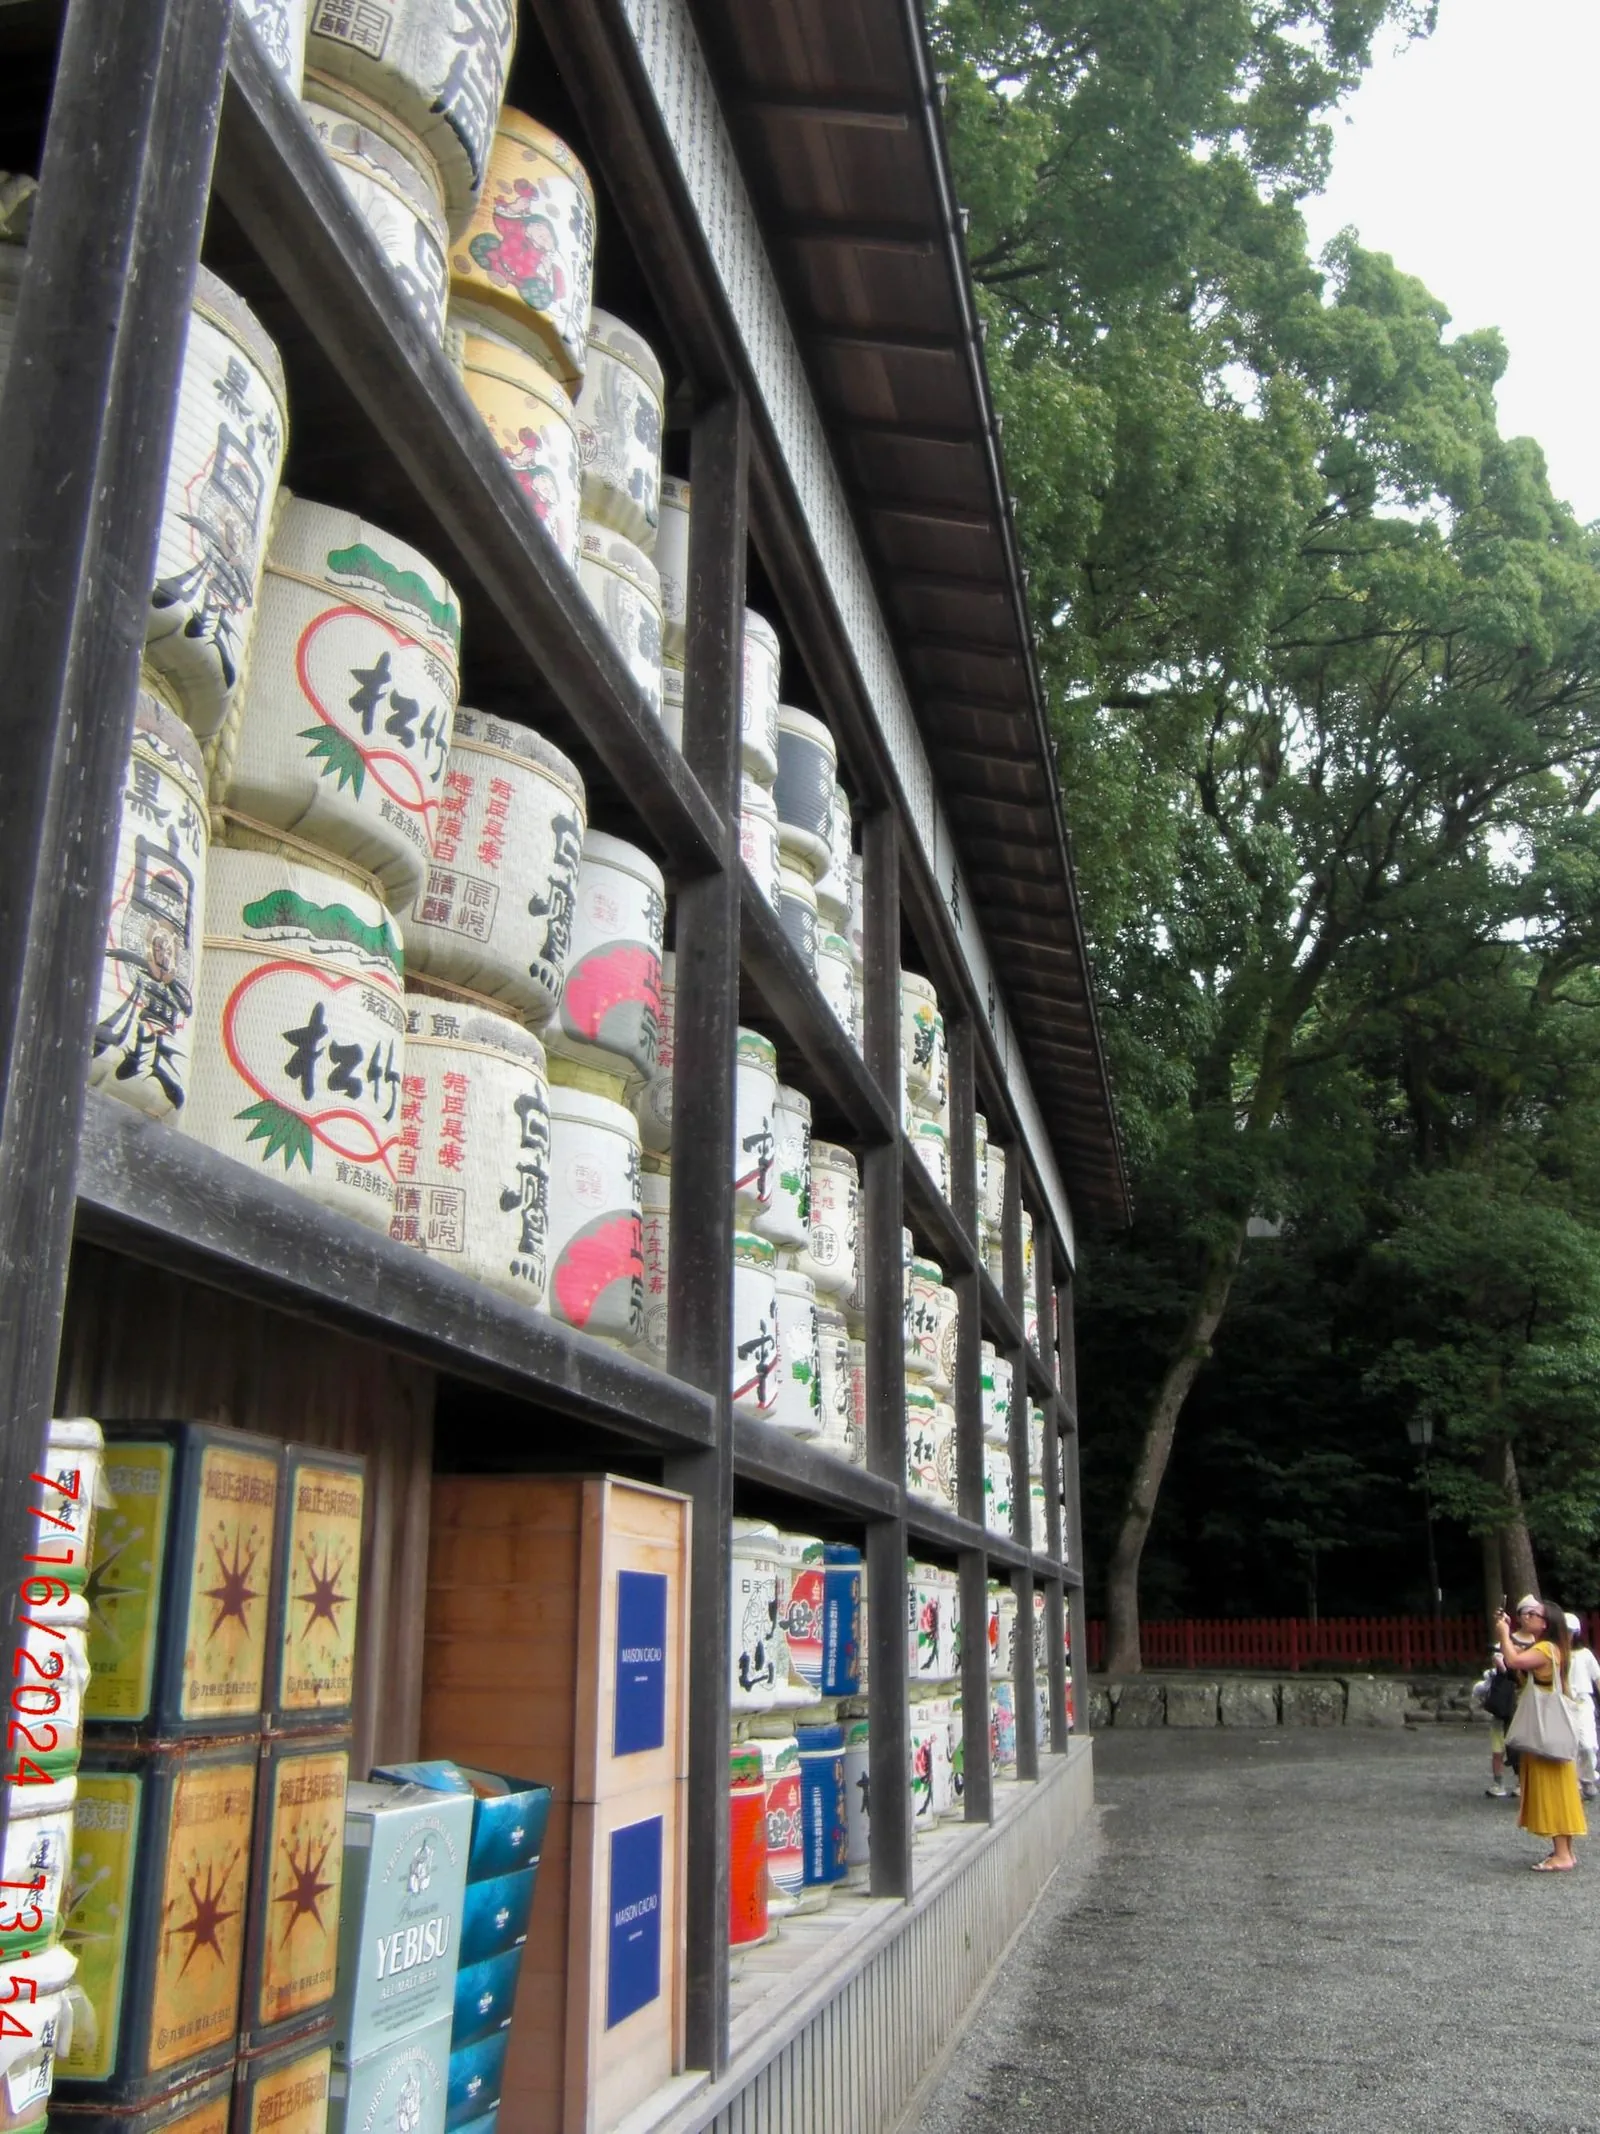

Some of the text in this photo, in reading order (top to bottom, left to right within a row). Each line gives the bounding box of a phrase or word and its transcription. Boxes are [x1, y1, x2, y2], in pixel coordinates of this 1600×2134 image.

[282, 1000, 402, 1123] 松竹
[622, 1647, 662, 1662] MAISON CACAO
[614, 1894, 658, 1928] MAISON CACAO
[376, 1914, 451, 1983] YEBISU
